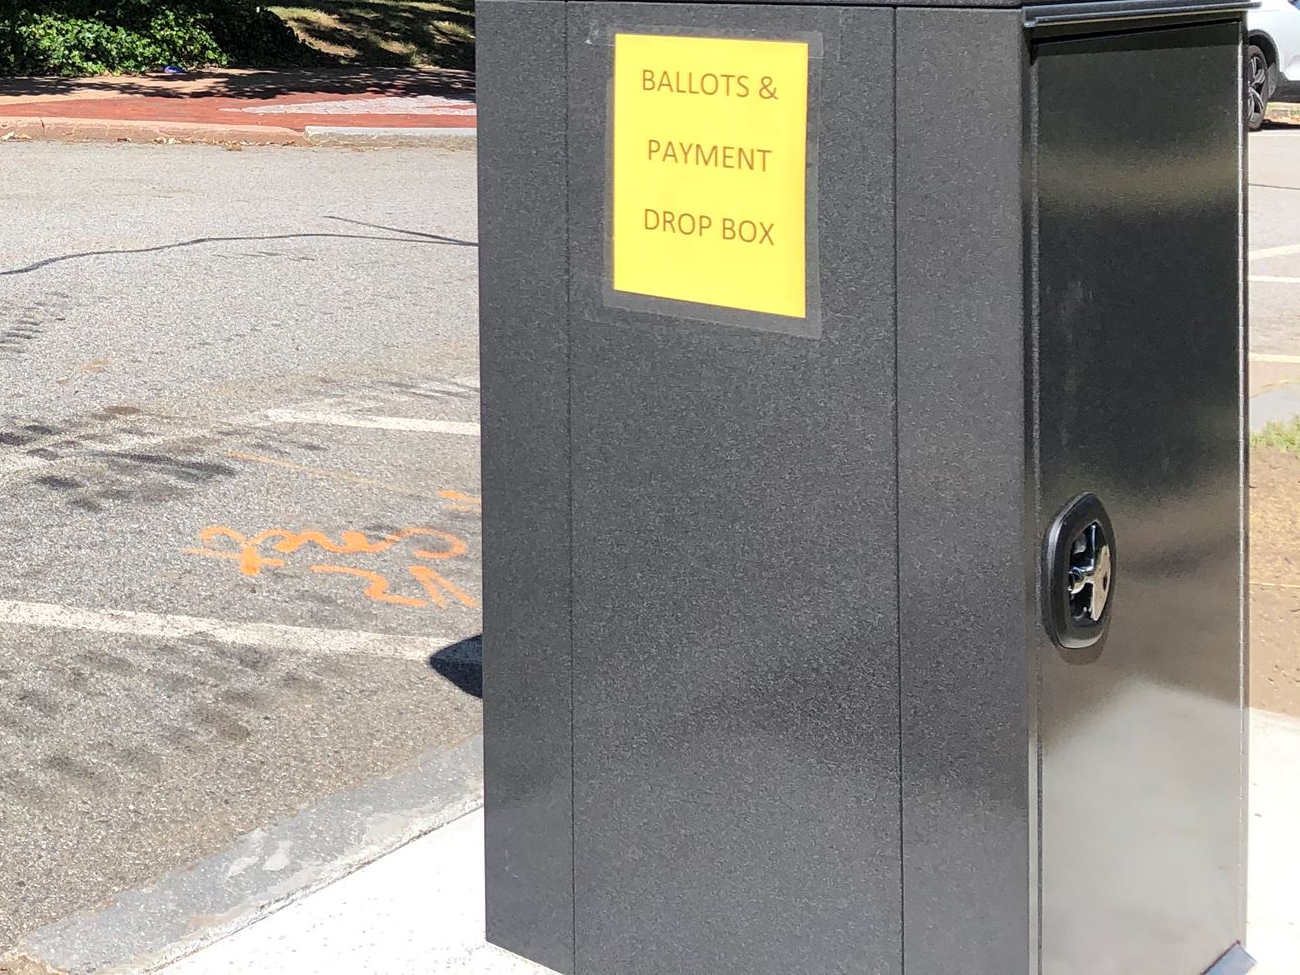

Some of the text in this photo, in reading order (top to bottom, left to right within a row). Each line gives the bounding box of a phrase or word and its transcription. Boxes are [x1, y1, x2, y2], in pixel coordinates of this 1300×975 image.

[642, 69, 779, 100] BALLOTS &
[648, 139, 773, 172] PAYMENT
[644, 208, 775, 246] DROP BOX
